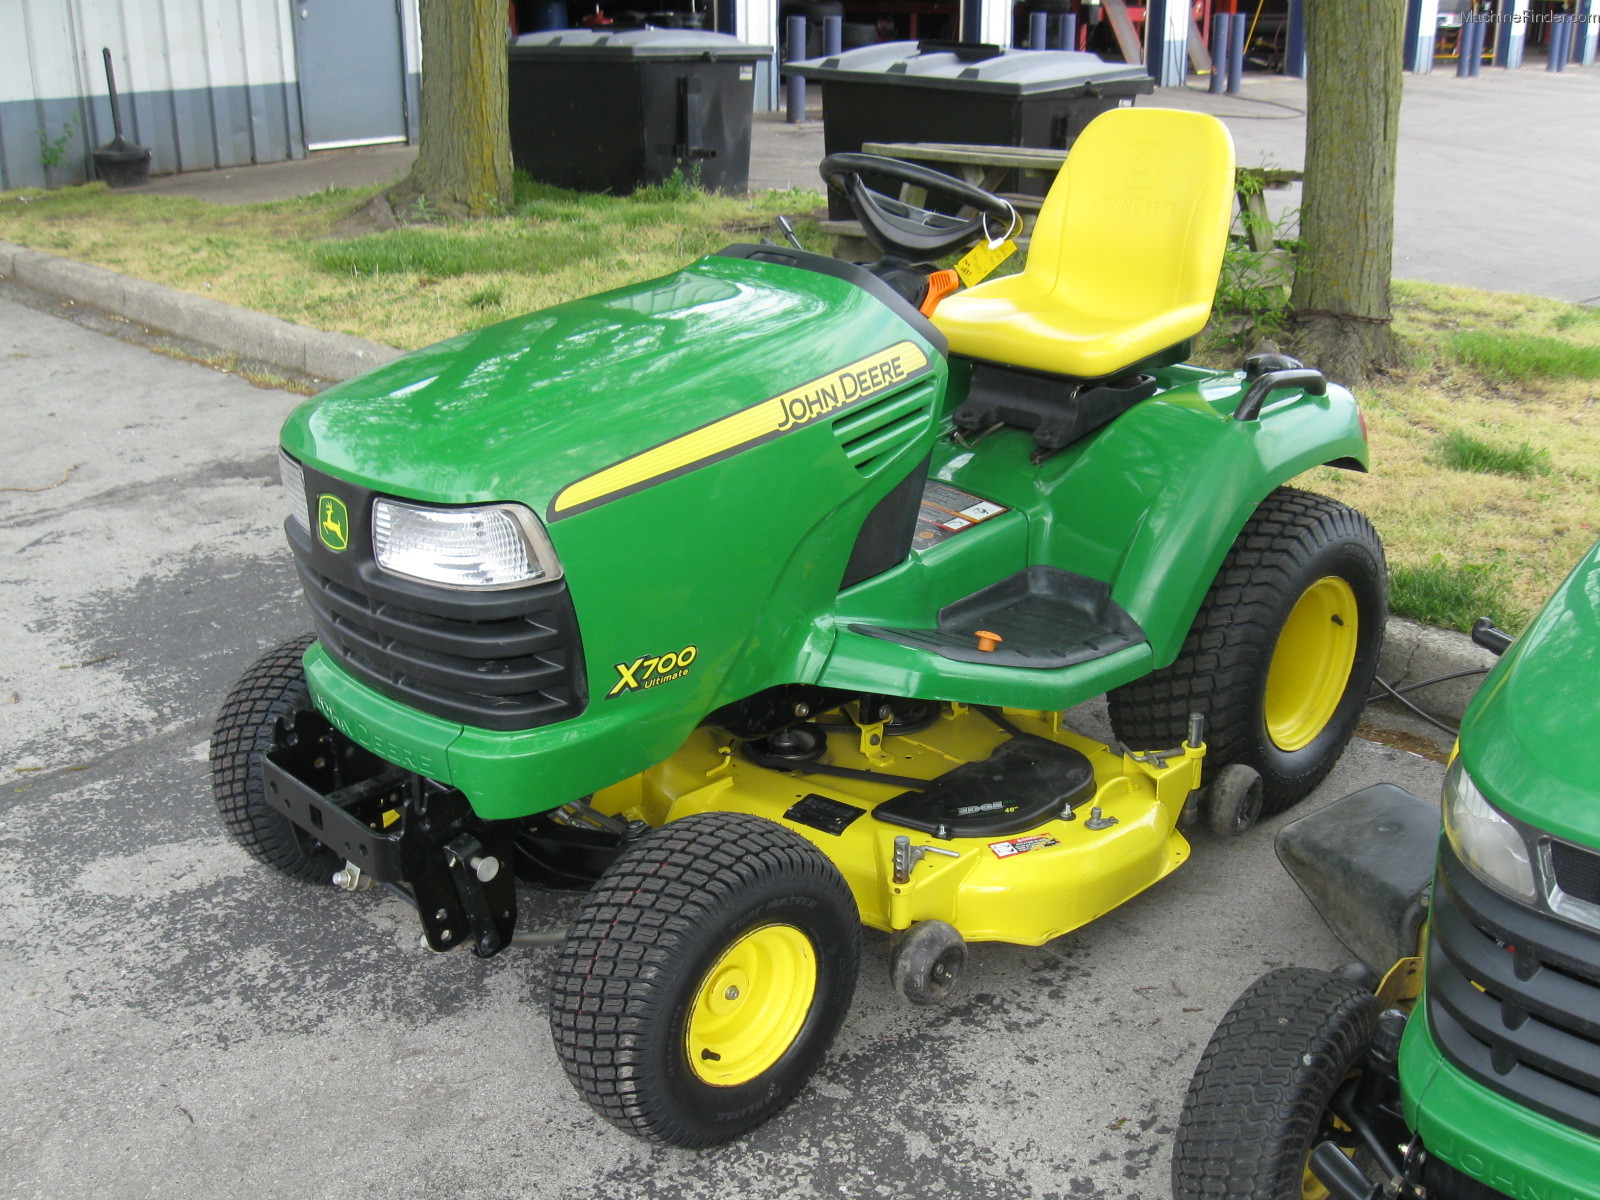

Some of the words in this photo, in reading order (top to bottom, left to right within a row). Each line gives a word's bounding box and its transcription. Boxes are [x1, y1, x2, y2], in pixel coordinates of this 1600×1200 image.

[778, 384, 838, 428] JOHN
[838, 356, 905, 400] DEERE
[605, 645, 698, 699] X700
[643, 668, 690, 689] Ultimate
[354, 721, 435, 776] DEERE
[957, 800, 1004, 816] EDGE
